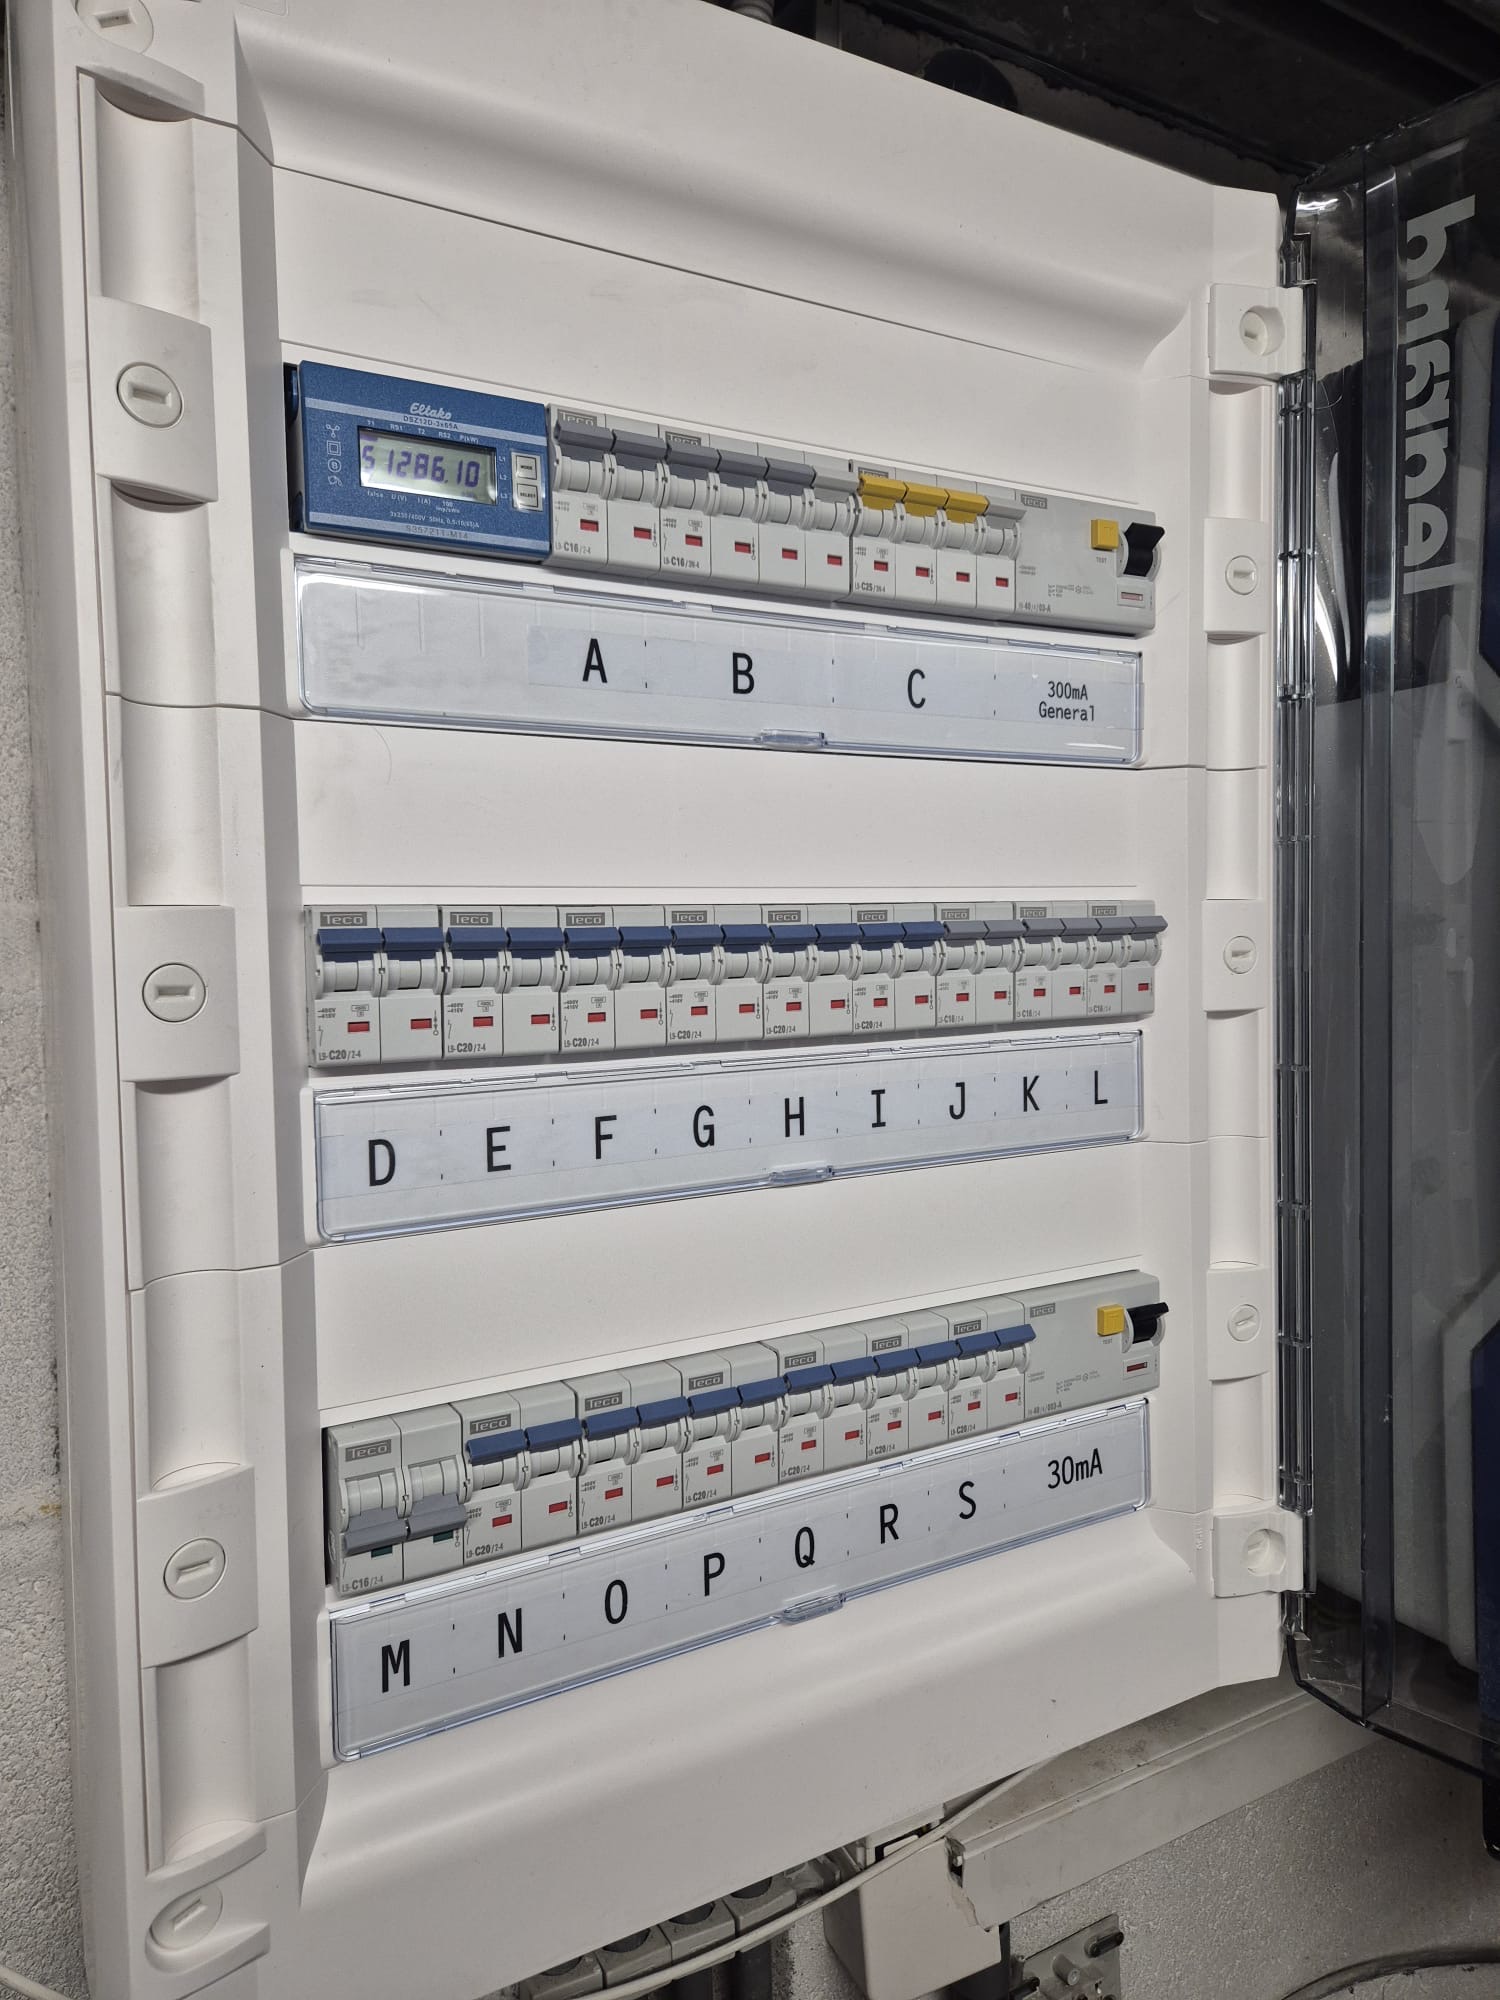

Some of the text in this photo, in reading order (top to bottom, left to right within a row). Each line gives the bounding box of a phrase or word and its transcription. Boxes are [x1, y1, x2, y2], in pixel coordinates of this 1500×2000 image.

[410, 402, 452, 420] Eltako
[583, 638, 607, 684] A
[733, 652, 754, 695] B
[908, 669, 925, 708] C
[1047, 680, 1089, 701] 300mA
[1038, 700, 1096, 722] General
[323, 913, 365, 925] Teco
[452, 913, 490, 925] Teco
[568, 914, 603, 925] Teco
[674, 912, 705, 922] Teco
[770, 912, 799, 922] Teco
[859, 911, 886, 921] Teco
[950, 1082, 966, 1119] J
[1023, 1076, 1040, 1112] K
[1095, 1071, 1108, 1105] L
[785, 1097, 804, 1138] H
[871, 1089, 886, 1128] I
[595, 1115, 617, 1160] F
[693, 1105, 714, 1149] G
[369, 1139, 395, 1187] D
[487, 1126, 511, 1173] E
[874, 1337, 900, 1350] Teco
[955, 1321, 980, 1334] Teco
[786, 1353, 815, 1367] Teco
[691, 1374, 722, 1389] Teco
[587, 1394, 620, 1410] Teco
[472, 1416, 509, 1433] Teco
[348, 1442, 389, 1460] Teco
[1048, 1448, 1103, 1490] 30mA
[959, 1481, 976, 1519] S
[880, 1504, 900, 1545] R
[795, 1527, 815, 1568] Q
[704, 1552, 726, 1597] P
[605, 1580, 628, 1625] O
[498, 1608, 523, 1659] N
[382, 1639, 410, 1694] M
